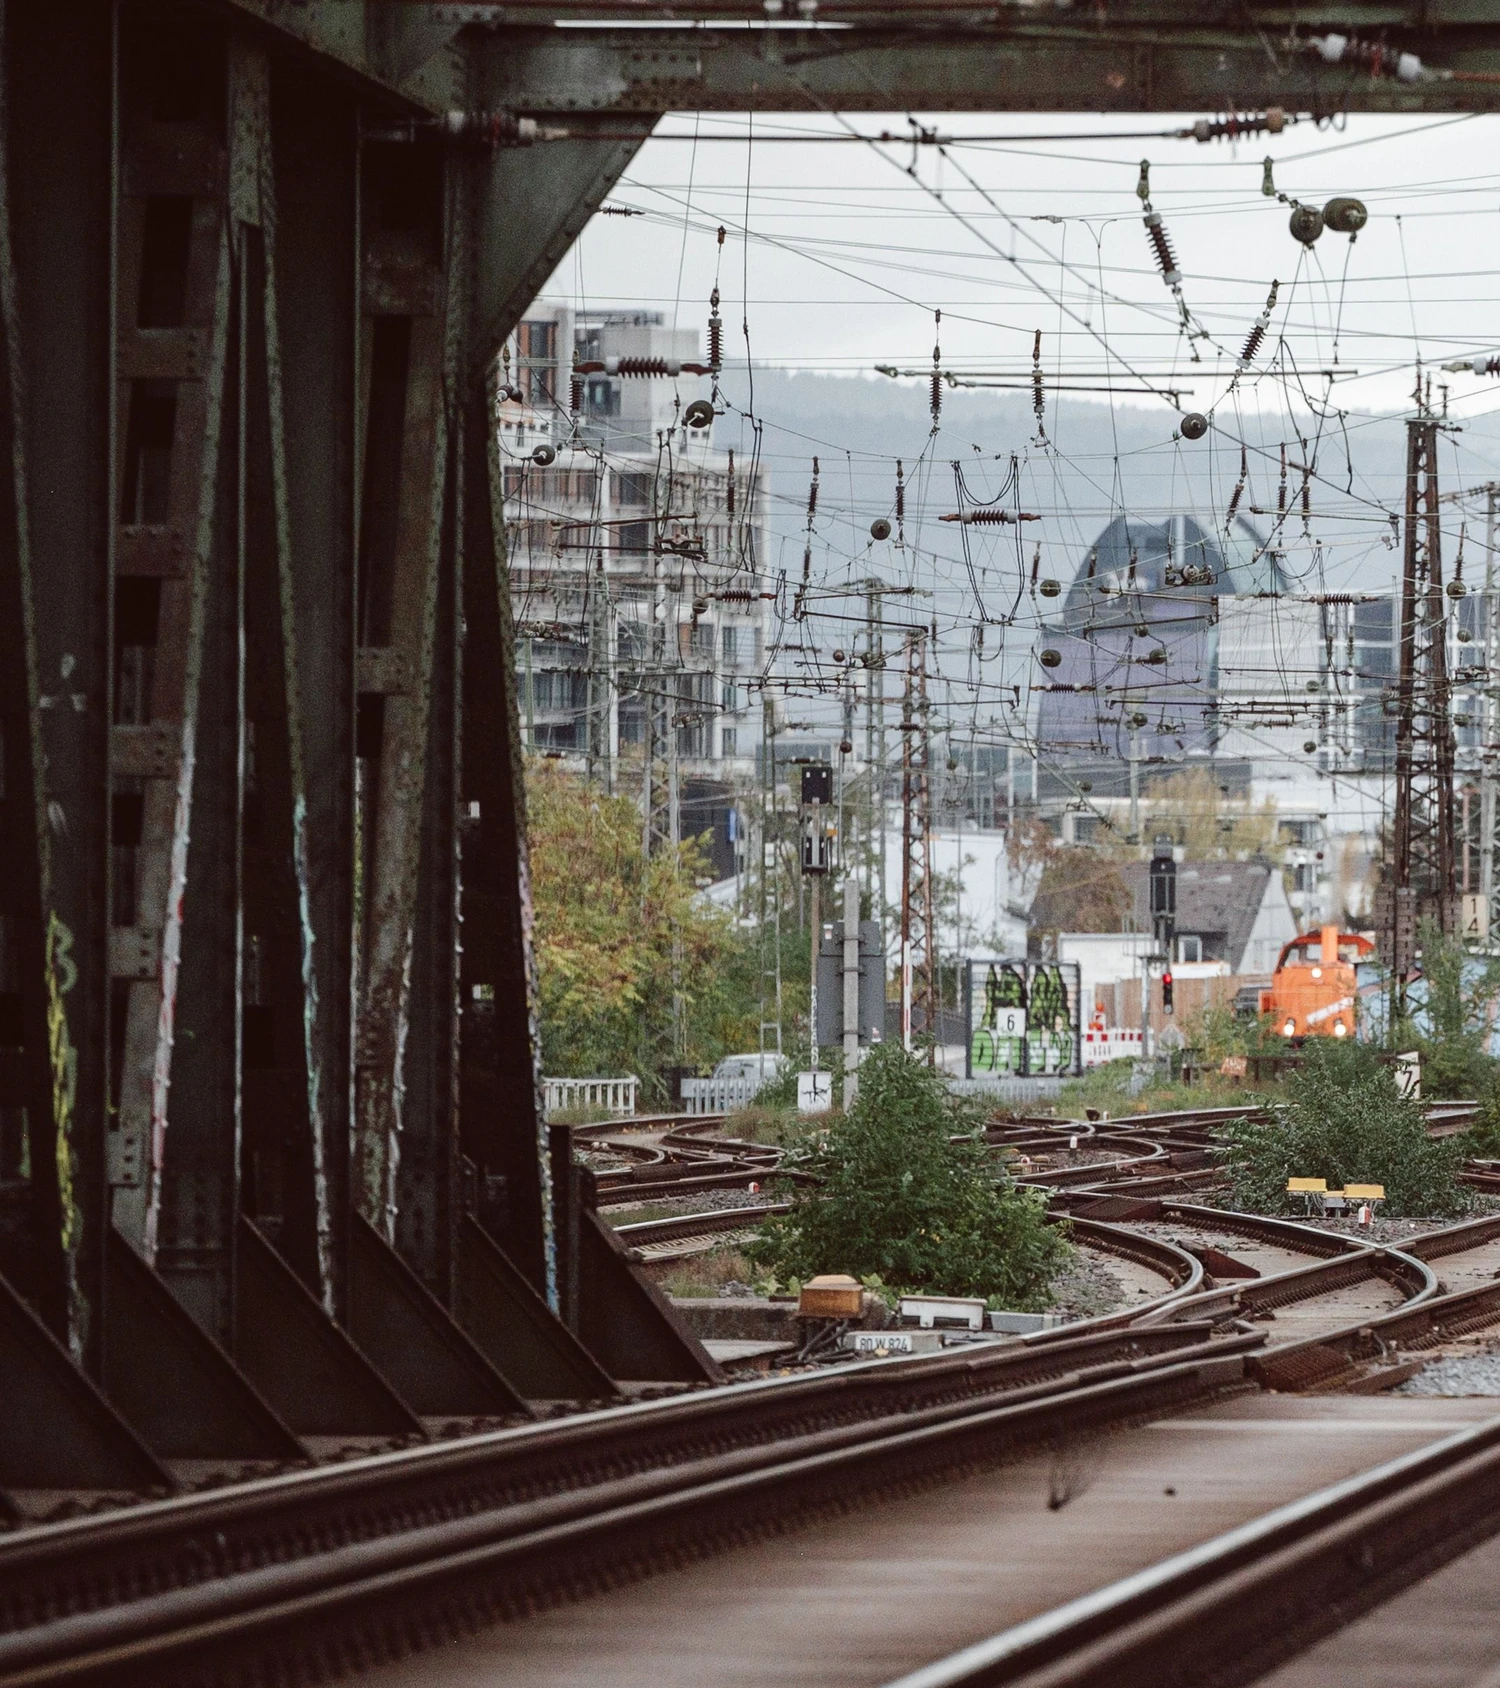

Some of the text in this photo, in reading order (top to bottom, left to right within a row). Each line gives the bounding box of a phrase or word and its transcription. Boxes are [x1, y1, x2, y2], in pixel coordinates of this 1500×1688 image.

[1471, 898, 1477, 915] 1
[1468, 917, 1479, 935] 4
[1007, 1014, 1016, 1033] 6
[1401, 1070, 1413, 1095] 7
[875, 1338, 886, 1350] W
[888, 1338, 908, 1352] 824
